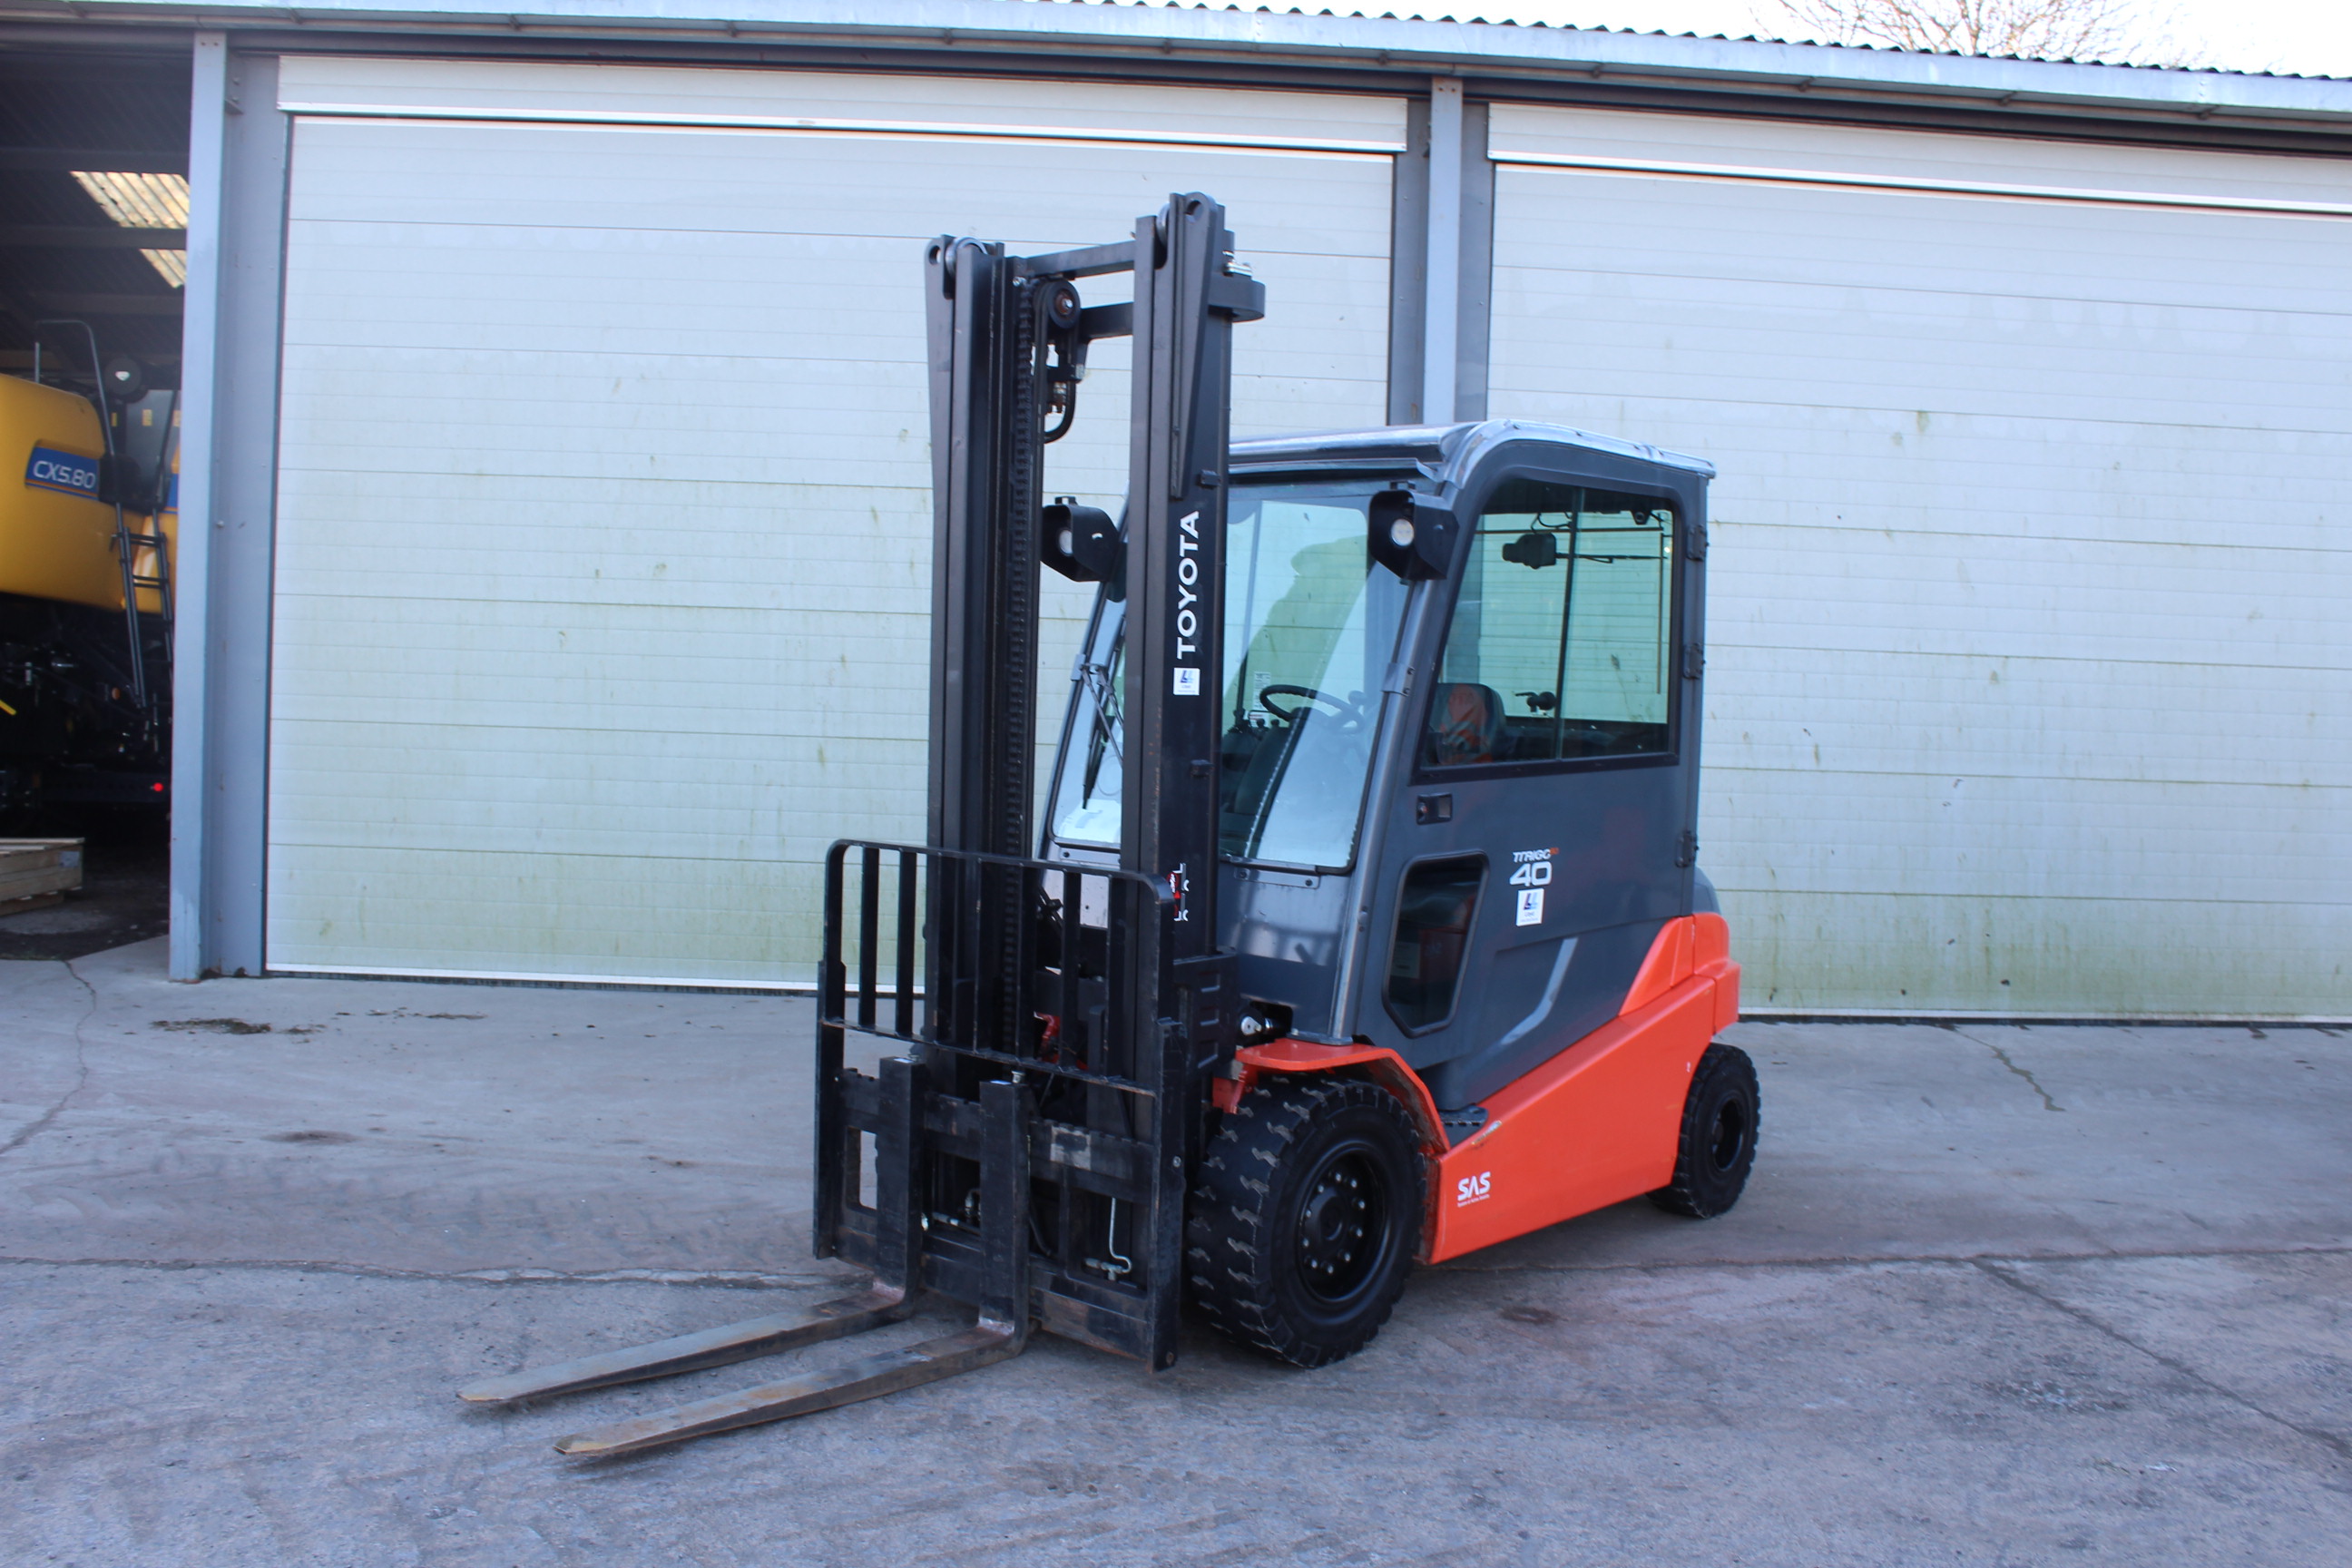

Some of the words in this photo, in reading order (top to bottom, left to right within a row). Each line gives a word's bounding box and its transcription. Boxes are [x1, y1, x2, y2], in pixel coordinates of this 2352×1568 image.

[33, 460, 96, 489] CX5.80
[1177, 511, 1200, 660] TOYOTA
[1509, 861, 1552, 887] 40
[1457, 1171, 1491, 1201] SAS
